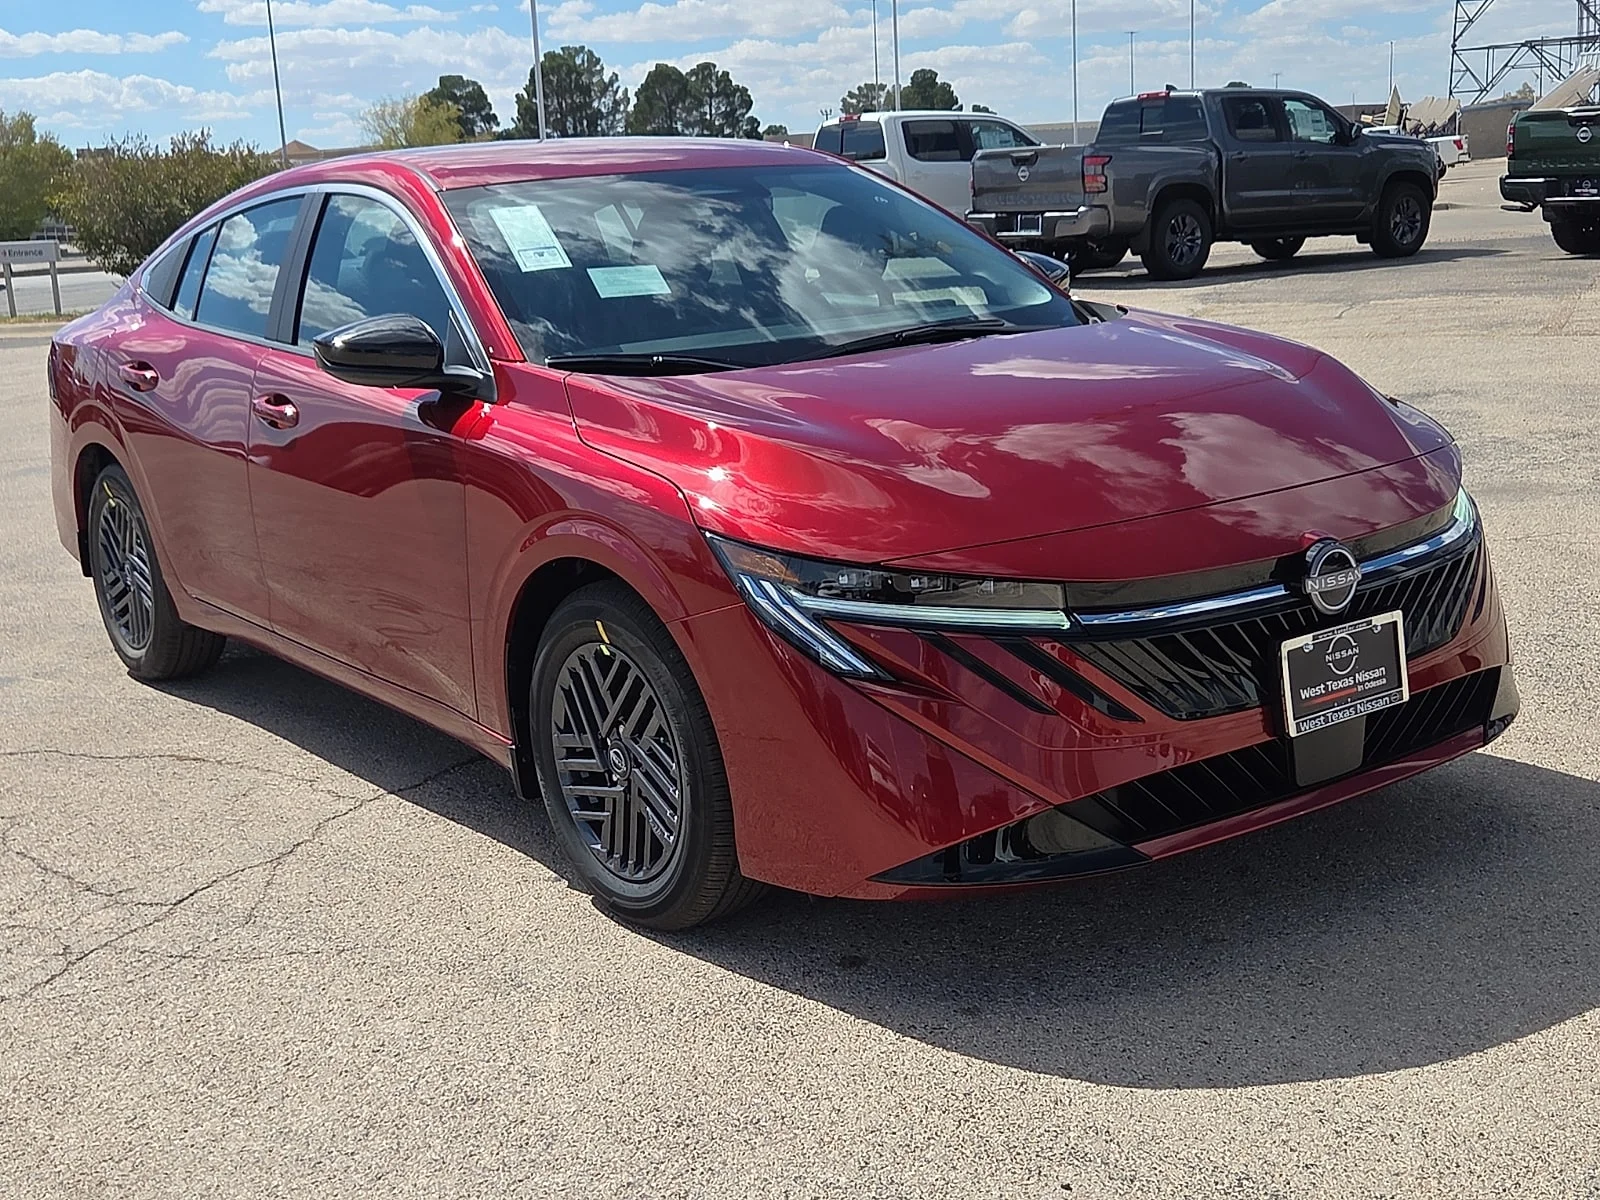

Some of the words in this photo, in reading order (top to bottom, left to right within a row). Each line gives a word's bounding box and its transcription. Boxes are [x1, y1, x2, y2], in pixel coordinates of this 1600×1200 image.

[8, 249, 43, 257] Entrance
[1308, 569, 1361, 590] NISSAN
[1325, 646, 1360, 662] NISSAN
[1300, 684, 1326, 700] West
[1326, 675, 1354, 692] Texas
[1355, 666, 1386, 684] Nissan
[1364, 678, 1387, 690] Odessa
[1300, 717, 1325, 731] West
[1325, 708, 1355, 722] Texas
[1356, 697, 1389, 713] Nissan
